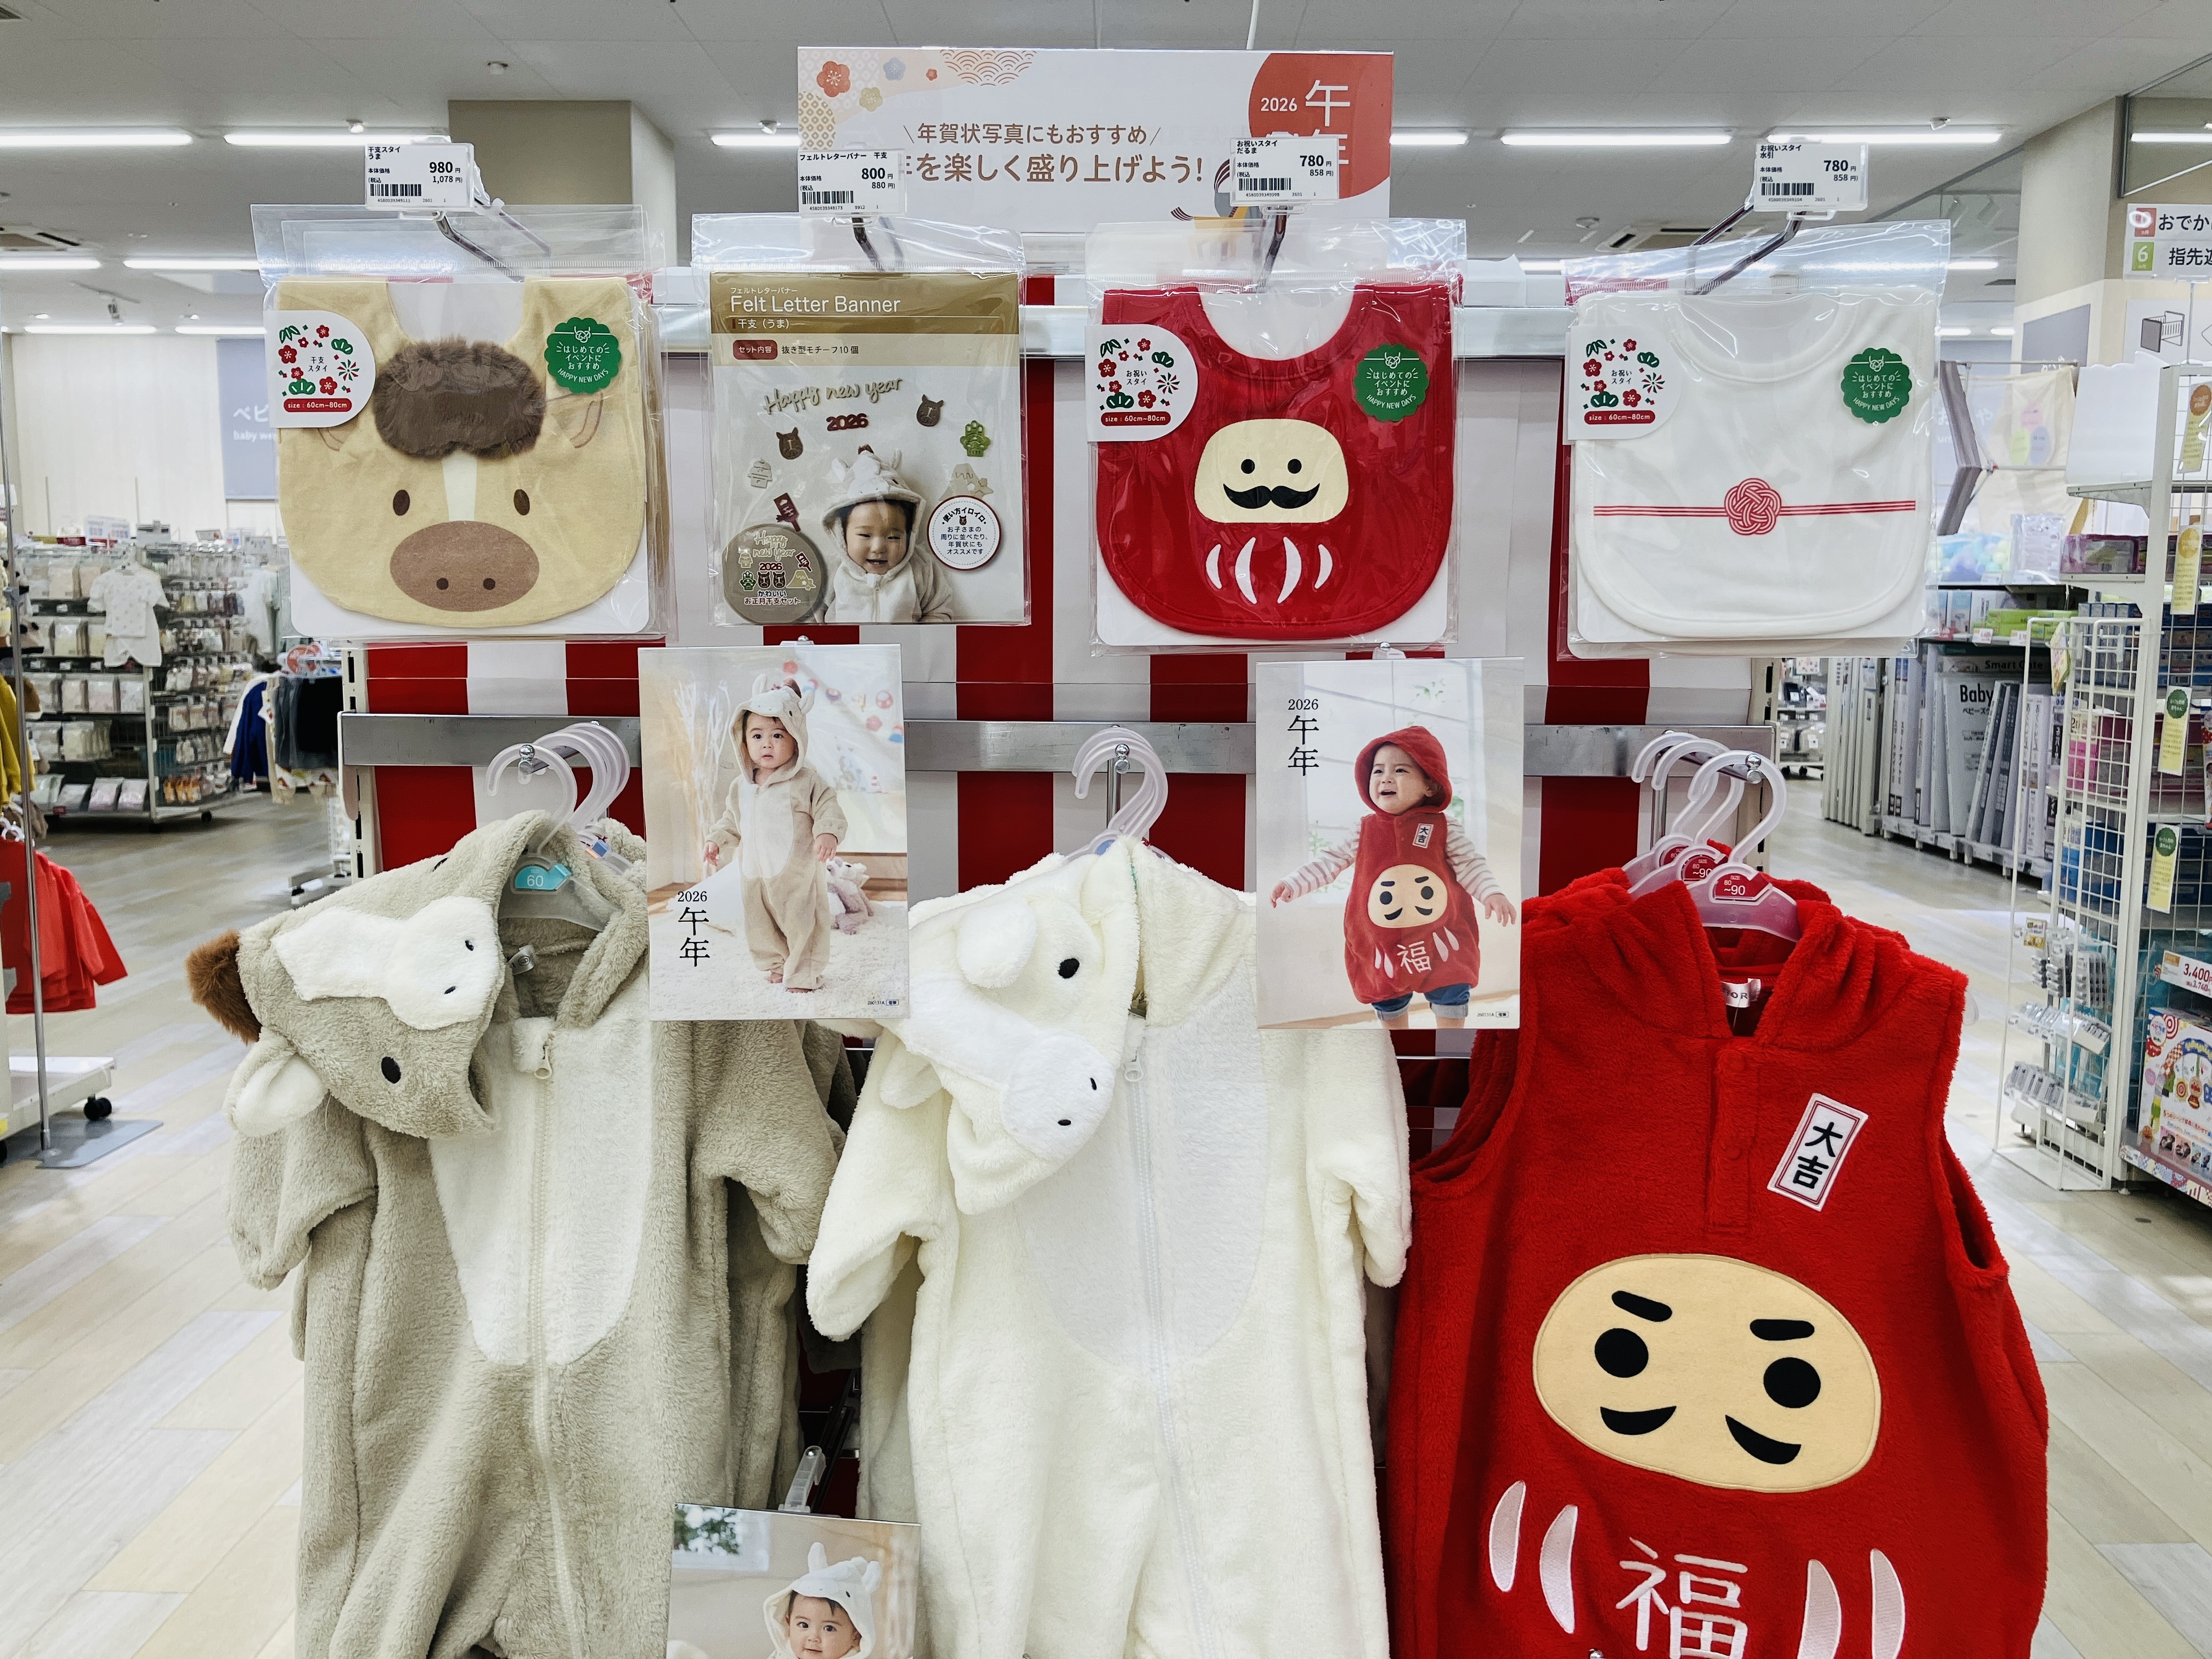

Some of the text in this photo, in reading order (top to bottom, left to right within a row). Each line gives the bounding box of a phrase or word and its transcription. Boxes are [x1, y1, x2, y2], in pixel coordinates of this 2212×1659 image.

[1261, 98, 1297, 112] 2026
[917, 123, 1147, 144] 年賀状写真にもおすすめ
[906, 153, 1202, 182] を楽しく盛り上げよう!
[2158, 213, 2212, 231] おでか
[2137, 245, 2149, 262] 6
[731, 295, 901, 313] Felt Letter Banner
[563, 345, 603, 353] はじめての
[738, 346, 772, 354] セット内容
[568, 362, 600, 370] おすすめ
[557, 368, 578, 382] HAPPY
[593, 368, 608, 381] DAYS
[1373, 371, 1412, 380] はじめての
[1858, 374, 1895, 382] はじめての
[1376, 388, 1408, 396] おすすめ
[1860, 382, 1893, 391] イベントに
[763, 378, 903, 415] Happy new year
[1366, 394, 1386, 408] HAPPY
[1401, 394, 1417, 407] DAYS
[1863, 390, 1892, 398] おすすめ
[1853, 397, 1871, 410] HAPPY
[1886, 396, 1900, 409] DAYS
[826, 413, 868, 431] 2026
[754, 530, 788, 549] Happy
[752, 549, 796, 562] new year
[759, 562, 783, 571] 2026
[744, 597, 801, 605] お正月干支セット
[1984, 659, 2044, 669] Smart Gte
[1288, 699, 1319, 710] 2026
[1287, 715, 1319, 776] 午年
[1418, 826, 1429, 844] 大吉
[527, 874, 544, 887] 60
[677, 890, 708, 902] 2026
[678, 906, 710, 968] 午年
[1397, 940, 1432, 974] 福
[1791, 1120, 1844, 1190] 大吉
[1616, 1537, 1748, 1659] 福
